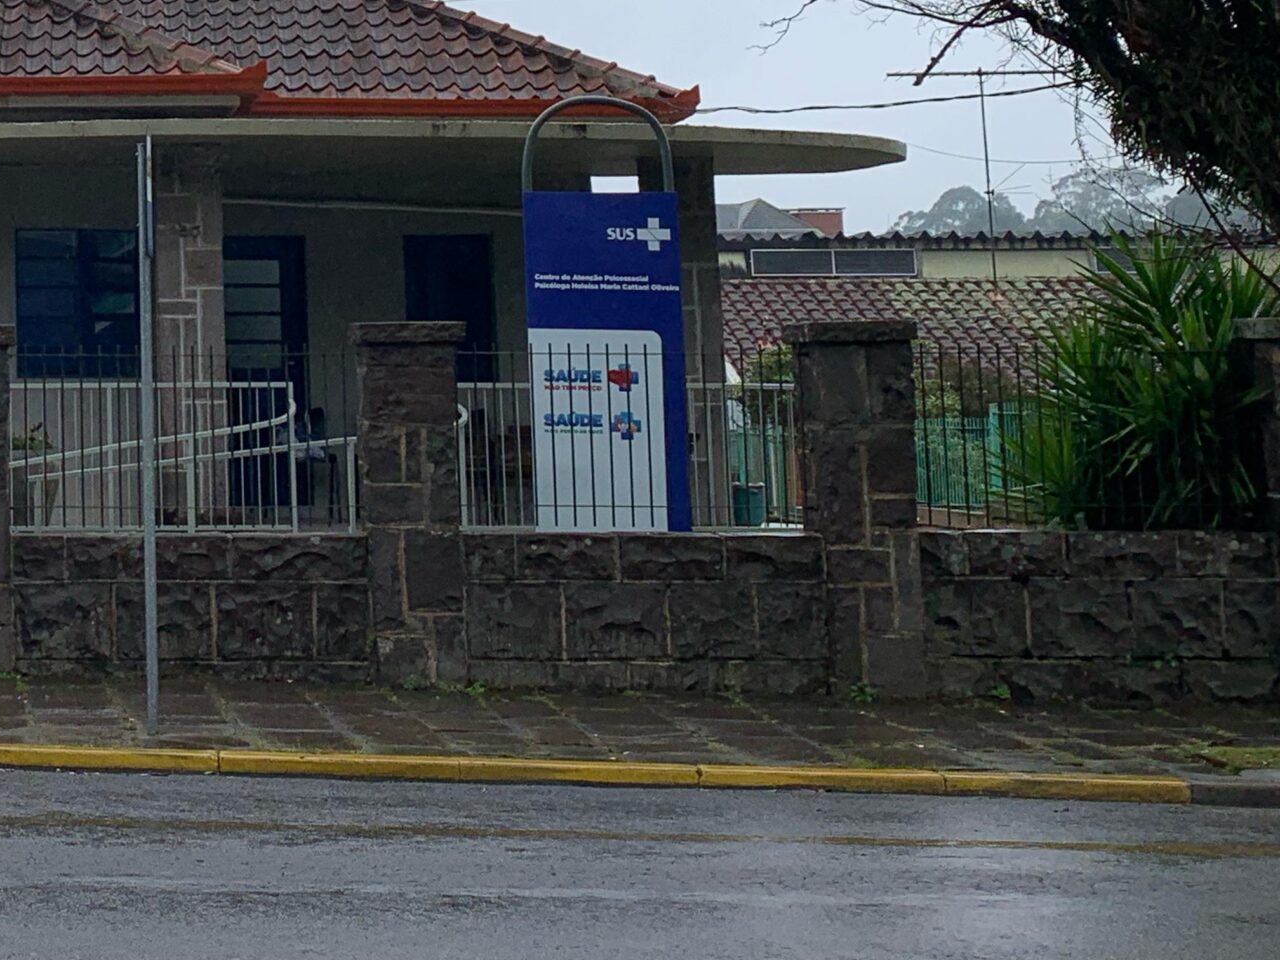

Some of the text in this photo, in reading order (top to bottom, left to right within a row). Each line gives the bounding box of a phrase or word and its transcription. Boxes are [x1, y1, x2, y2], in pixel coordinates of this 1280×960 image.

[606, 227, 635, 240] SUS
[534, 273, 560, 281] Centro
[572, 274, 603, 282] Atenção
[604, 274, 649, 282] Psicossocial
[544, 367, 602, 383] SAÚDE
[544, 412, 603, 427] SAÚDE
